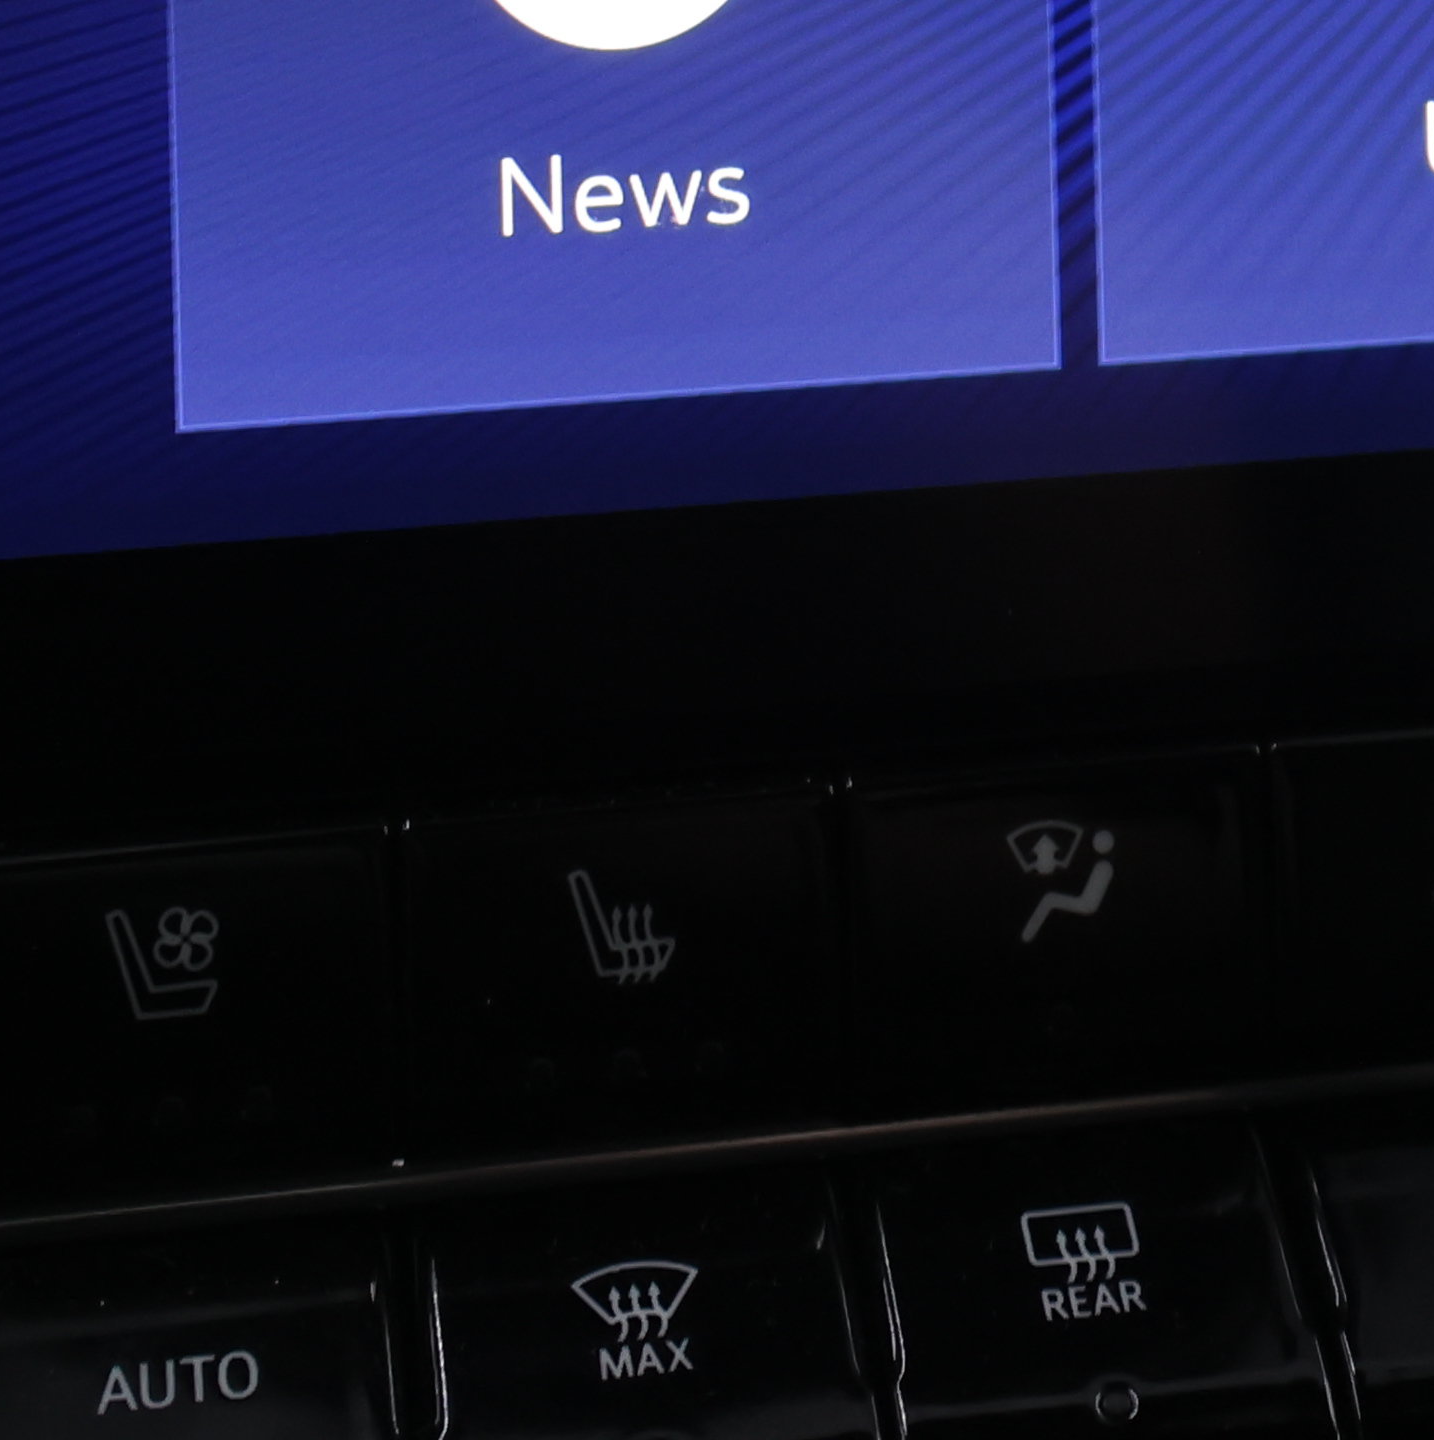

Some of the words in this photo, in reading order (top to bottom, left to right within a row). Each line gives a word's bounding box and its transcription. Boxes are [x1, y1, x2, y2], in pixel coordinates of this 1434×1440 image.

[499, 152, 752, 239] News
[1040, 1276, 1147, 1322] REAR
[96, 1349, 260, 1416] AUTO
[598, 1336, 695, 1383] MAX
